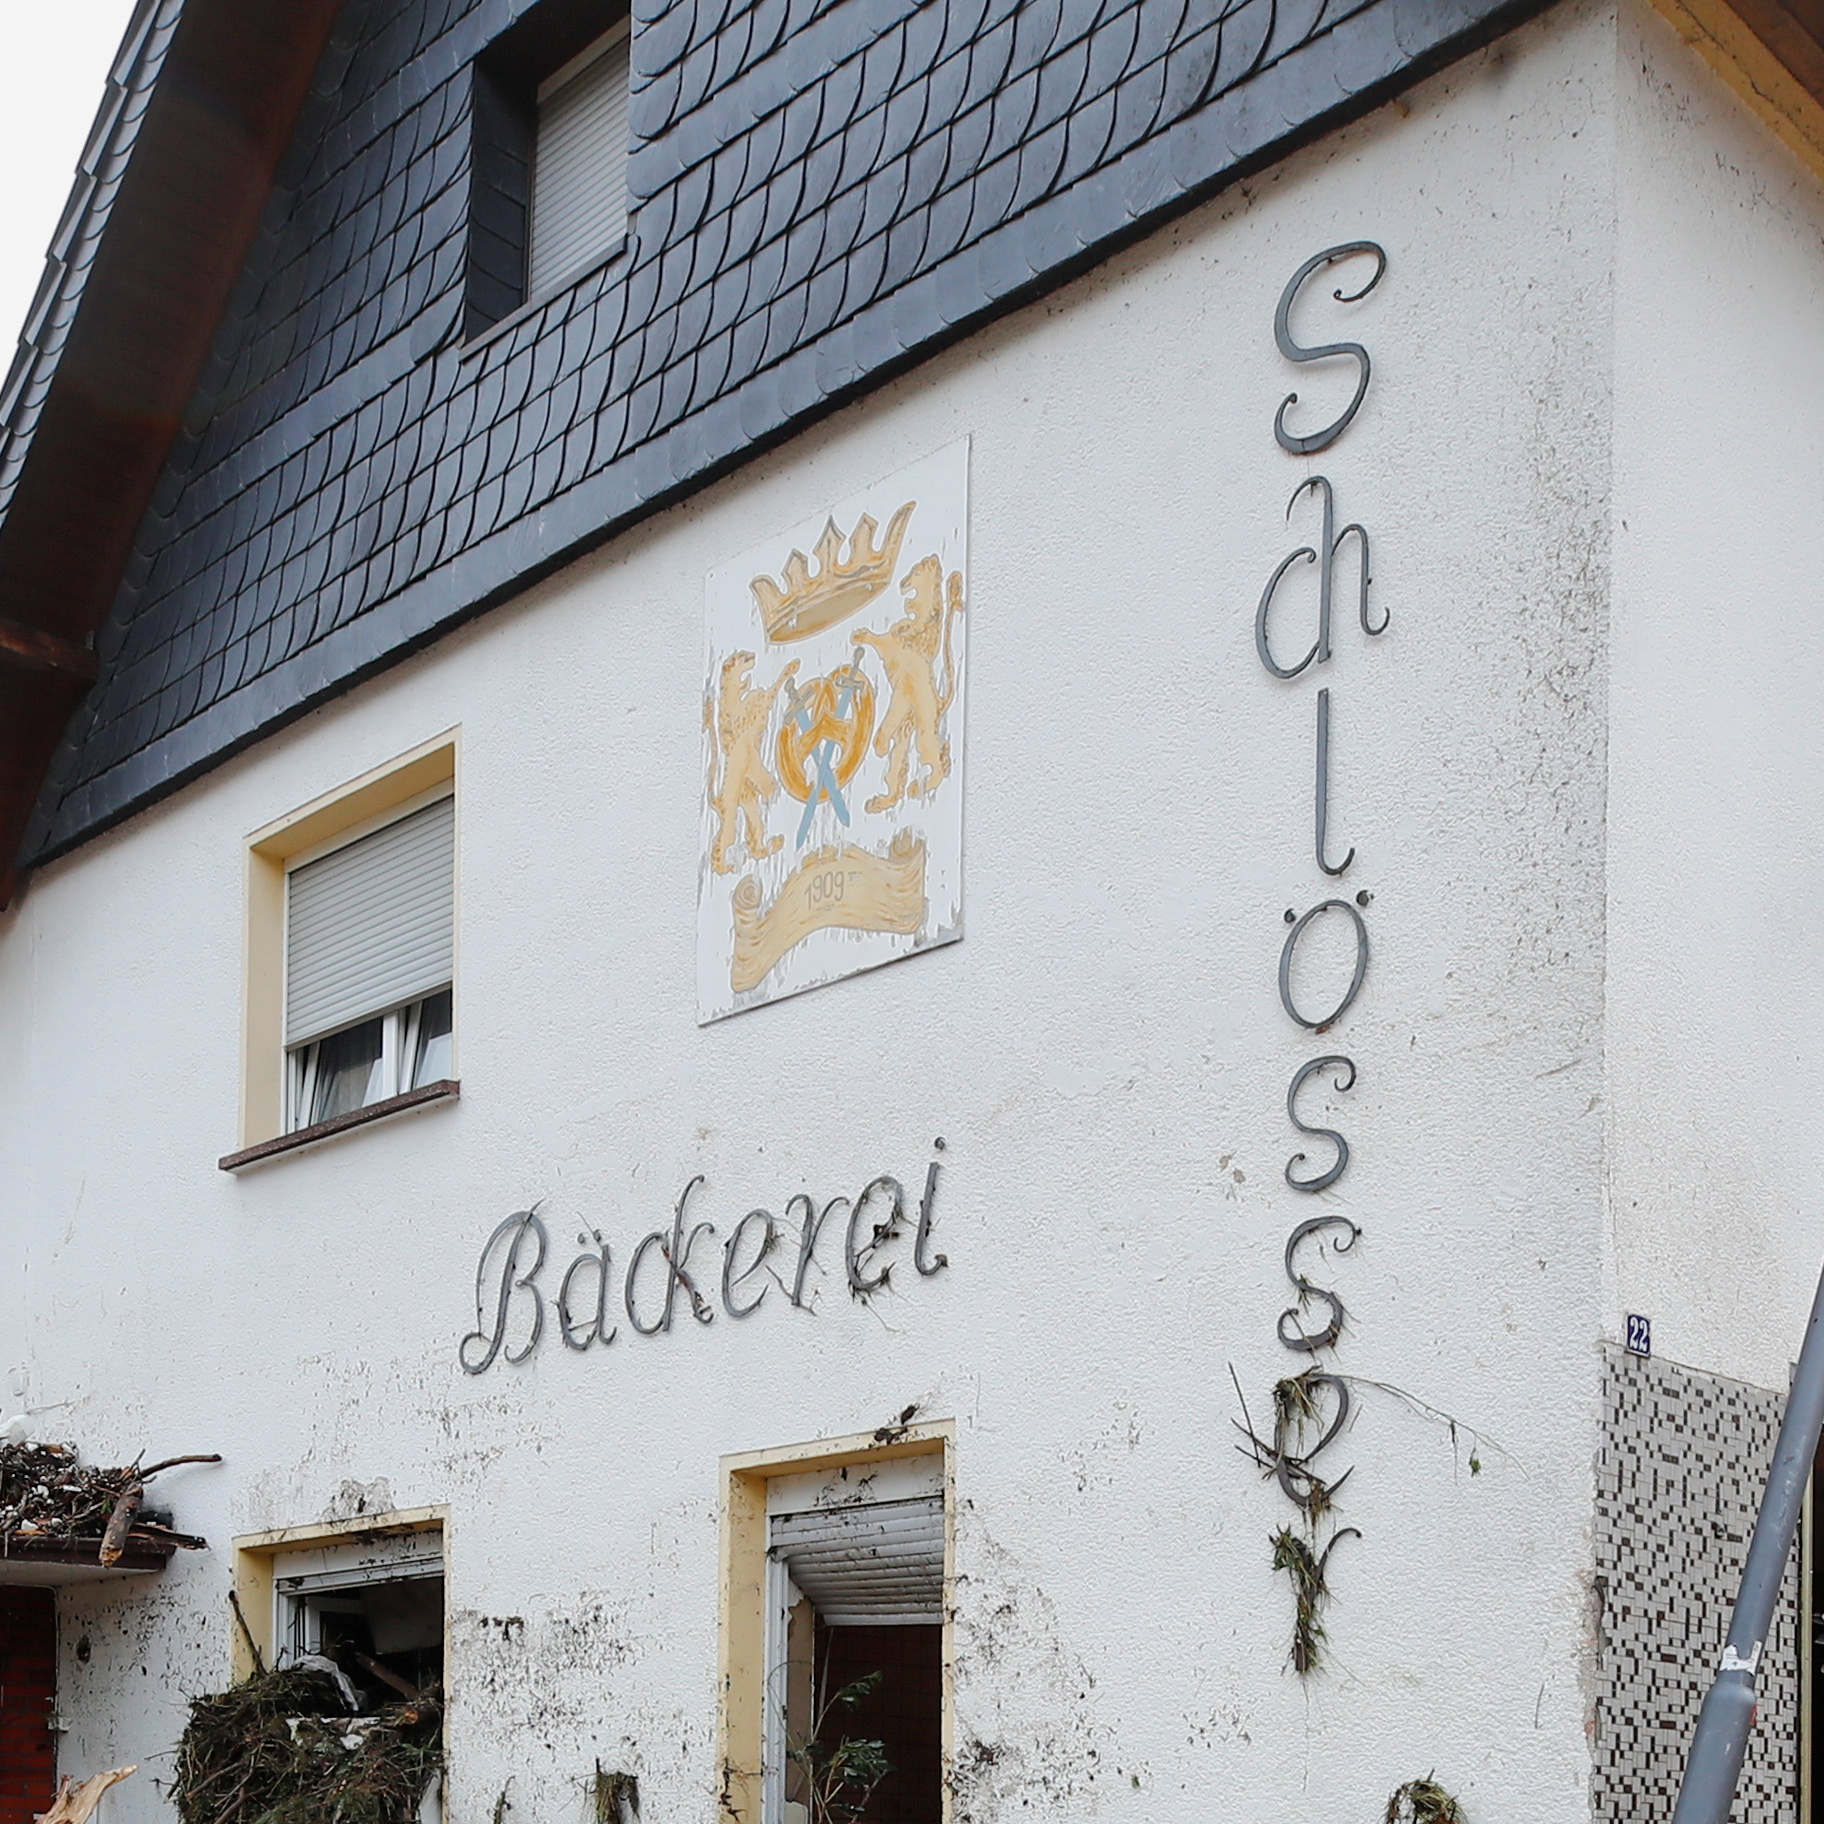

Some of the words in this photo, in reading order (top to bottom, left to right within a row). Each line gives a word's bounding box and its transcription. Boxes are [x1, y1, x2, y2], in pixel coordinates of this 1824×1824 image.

[804, 871, 844, 911] 1909
[458, 1136, 949, 1375] Bäckerei
[1630, 1316, 1648, 1352] 22
